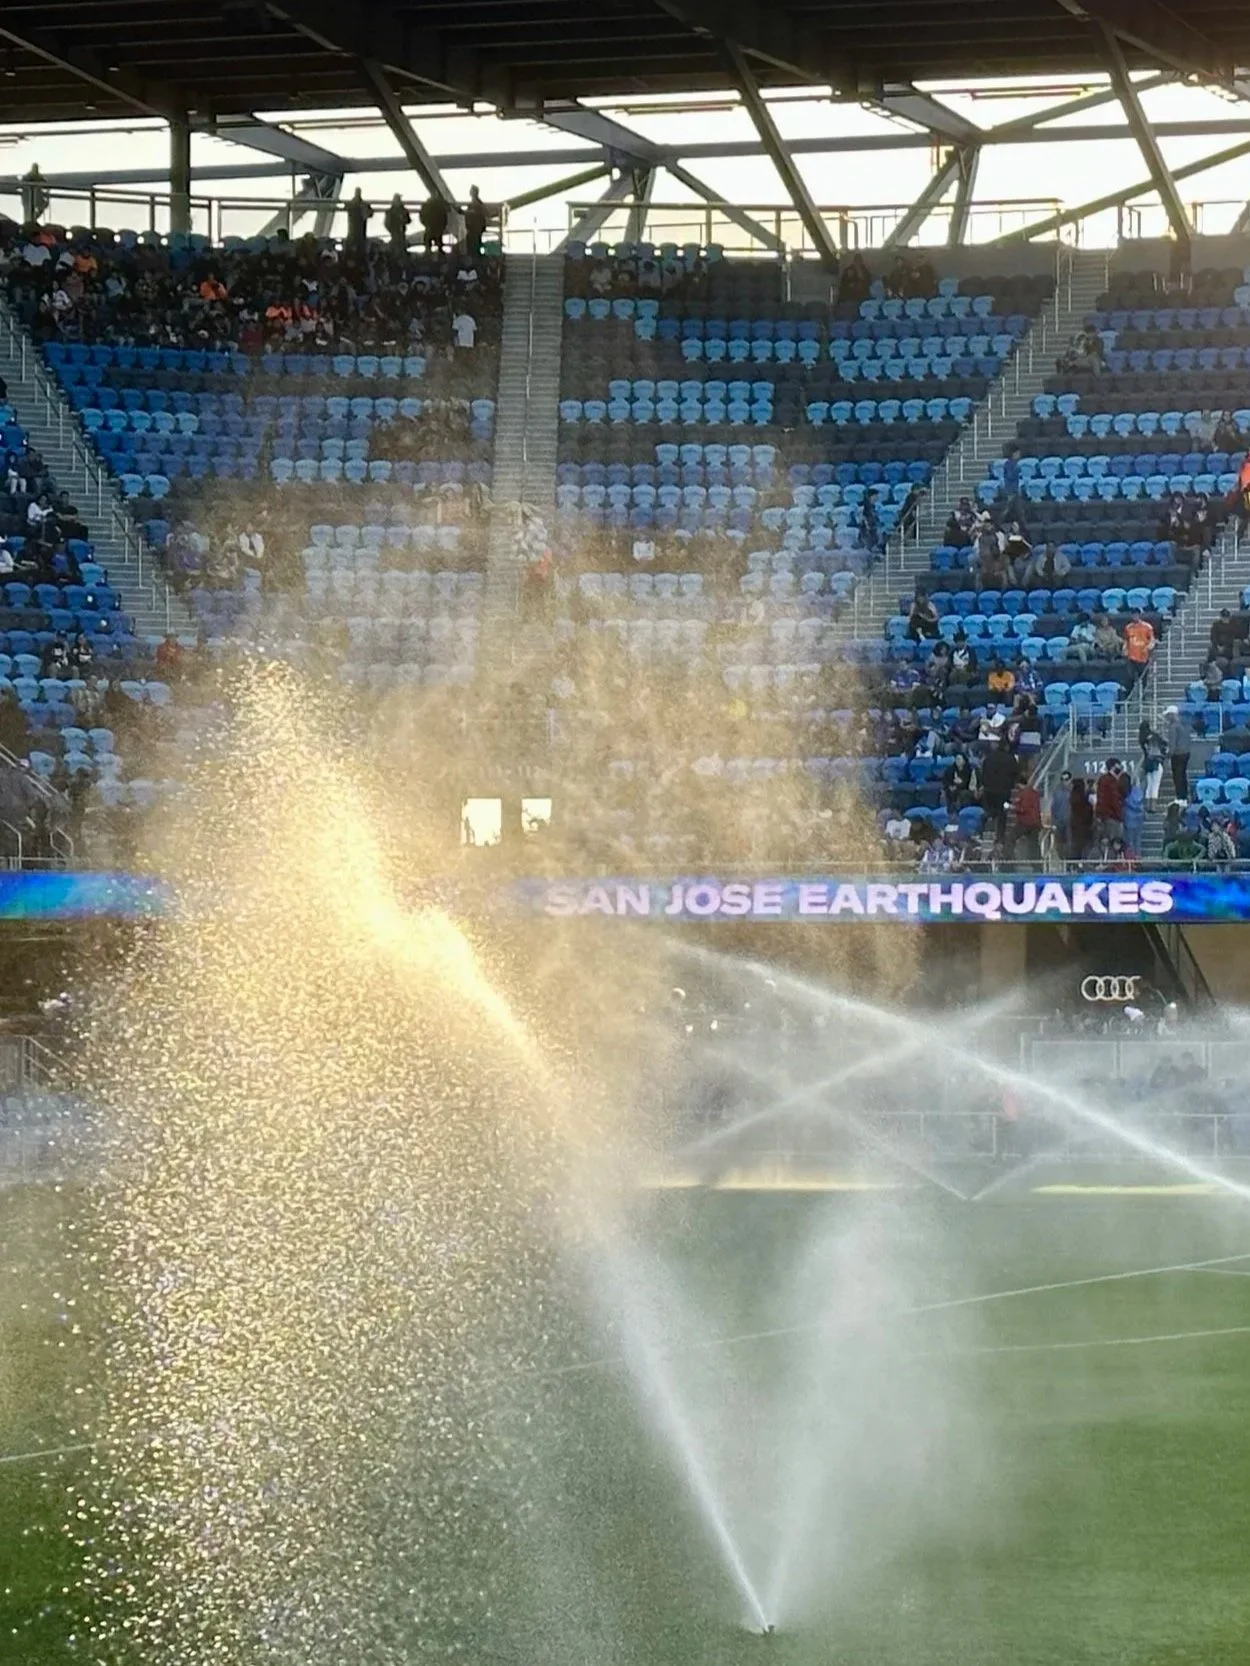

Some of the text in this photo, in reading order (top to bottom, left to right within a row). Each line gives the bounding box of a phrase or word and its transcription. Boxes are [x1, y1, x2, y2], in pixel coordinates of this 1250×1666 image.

[545, 882, 1174, 920] SAN JOSE EARTHQUAKES
